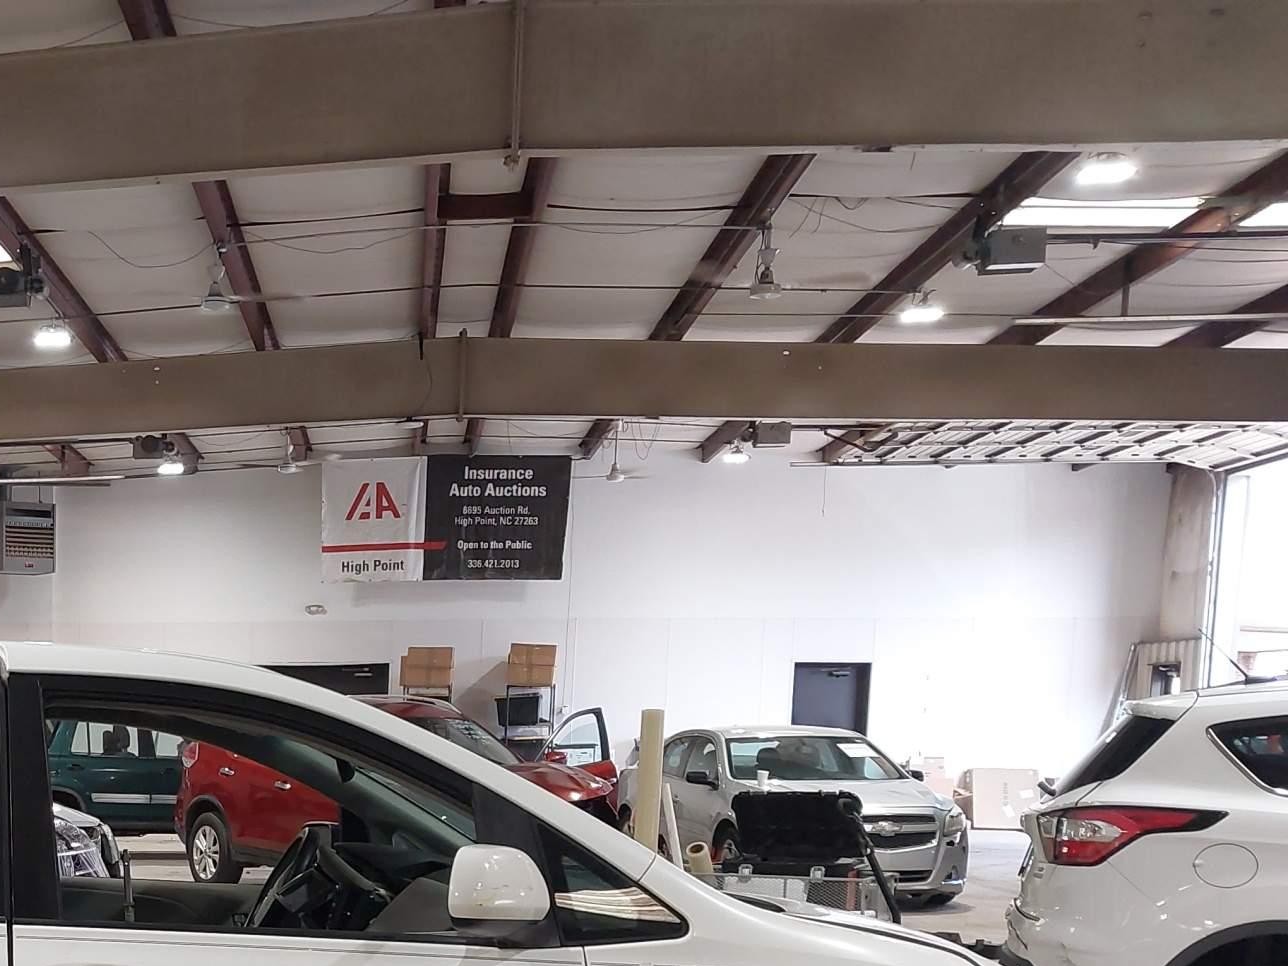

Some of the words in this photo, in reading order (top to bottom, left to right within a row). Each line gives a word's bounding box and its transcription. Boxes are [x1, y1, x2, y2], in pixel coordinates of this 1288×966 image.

[464, 465, 534, 480] Insurance
[449, 482, 481, 497] Auto
[484, 482, 547, 497] Auctions
[484, 505, 515, 515] Auction
[517, 505, 531, 515] Rd.
[454, 516, 473, 527] High
[475, 516, 498, 526] Point,
[499, 516, 513, 526] NC
[513, 516, 539, 526] 27263
[457, 539, 479, 551] Open
[480, 540, 489, 549] to
[490, 539, 504, 549] the
[505, 539, 533, 549] Public
[341, 559, 370, 575] High
[373, 558, 405, 573] Point
